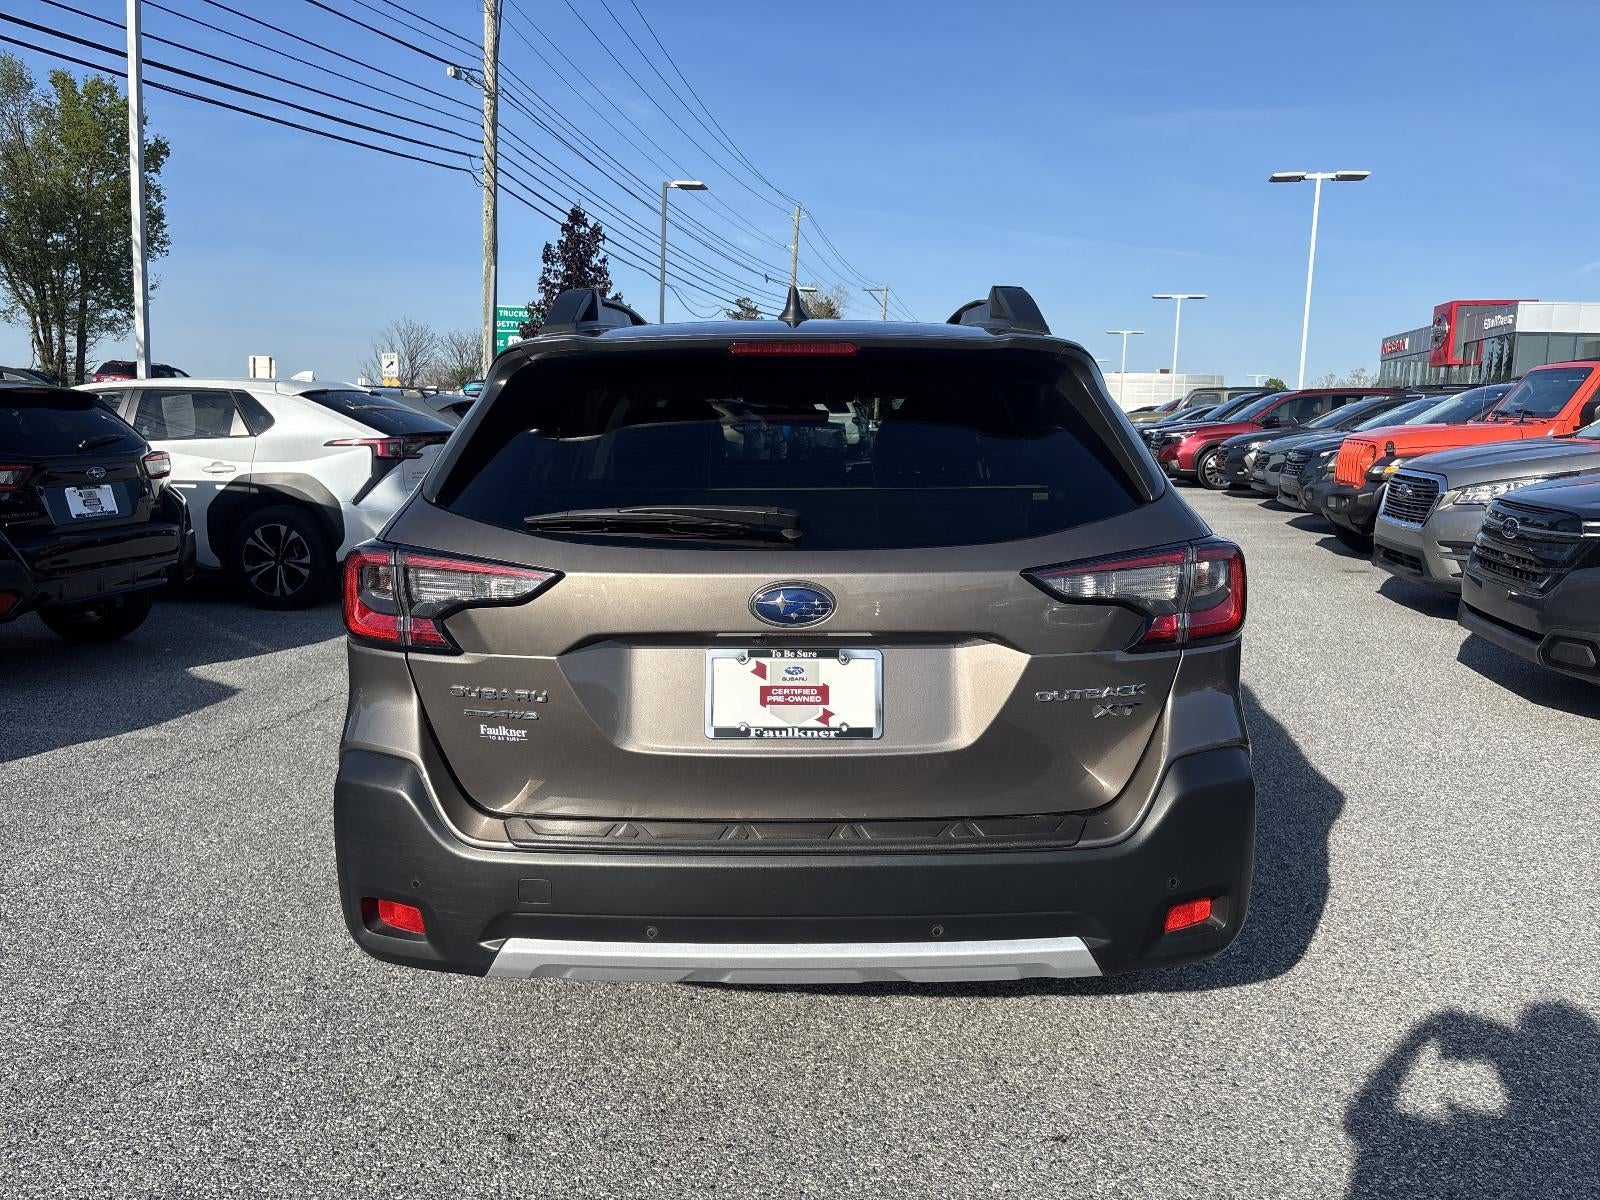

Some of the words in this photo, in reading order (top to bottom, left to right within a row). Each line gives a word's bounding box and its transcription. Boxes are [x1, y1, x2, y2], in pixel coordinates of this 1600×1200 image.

[771, 649, 781, 658] To
[784, 650, 795, 658] Be
[796, 649, 817, 658] Sure
[449, 685, 549, 703] SUBARU
[766, 695, 822, 703] PRE-OWNED
[1034, 683, 1147, 702] OUTBACK
[1092, 701, 1143, 719] XT
[480, 724, 527, 737] Faulkner
[749, 727, 840, 738] Faulkner
